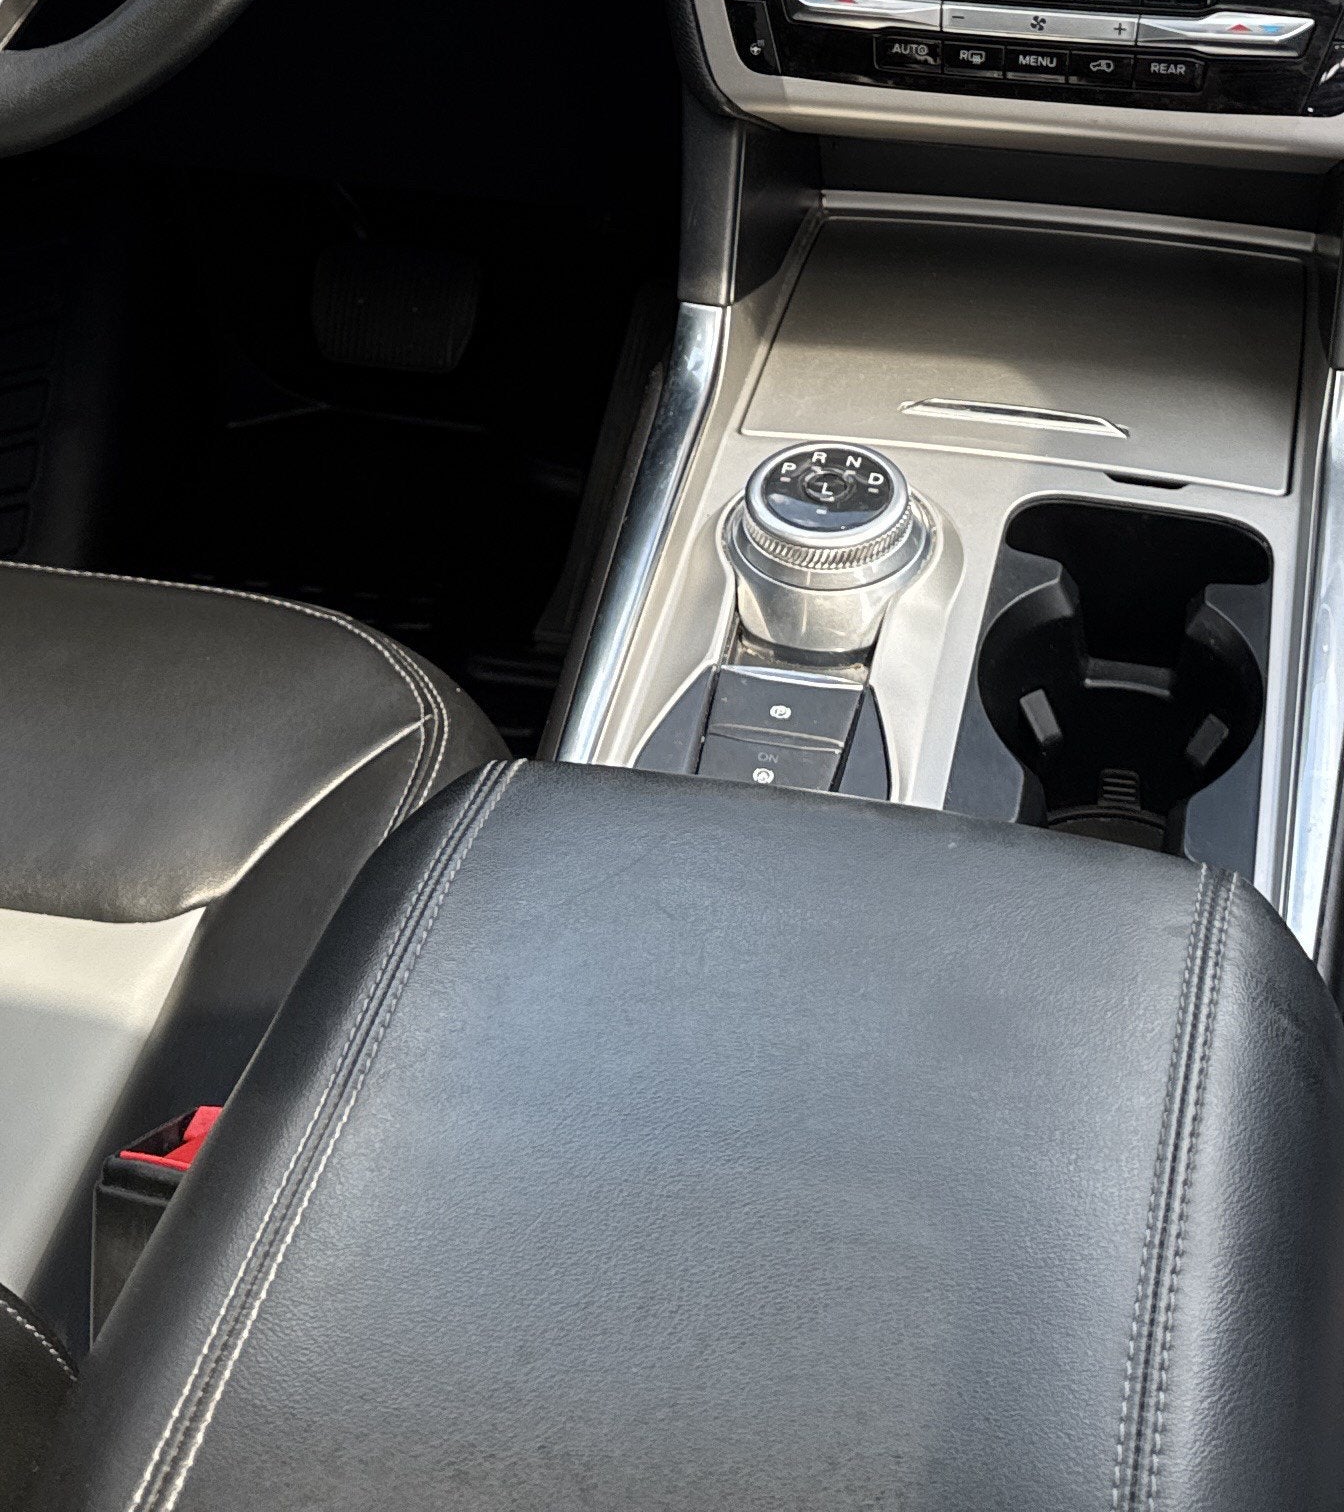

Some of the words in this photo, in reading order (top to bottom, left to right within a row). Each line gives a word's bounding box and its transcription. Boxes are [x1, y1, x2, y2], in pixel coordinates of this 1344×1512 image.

[891, 43, 929, 57] AUTO
[1018, 55, 1058, 68] MENU
[1150, 63, 1186, 76] REAR
[781, 462, 797, 476] P
[811, 451, 828, 465] R
[845, 454, 863, 469] N
[868, 472, 884, 485] D
[821, 481, 834, 496] L
[757, 752, 779, 763] ON
